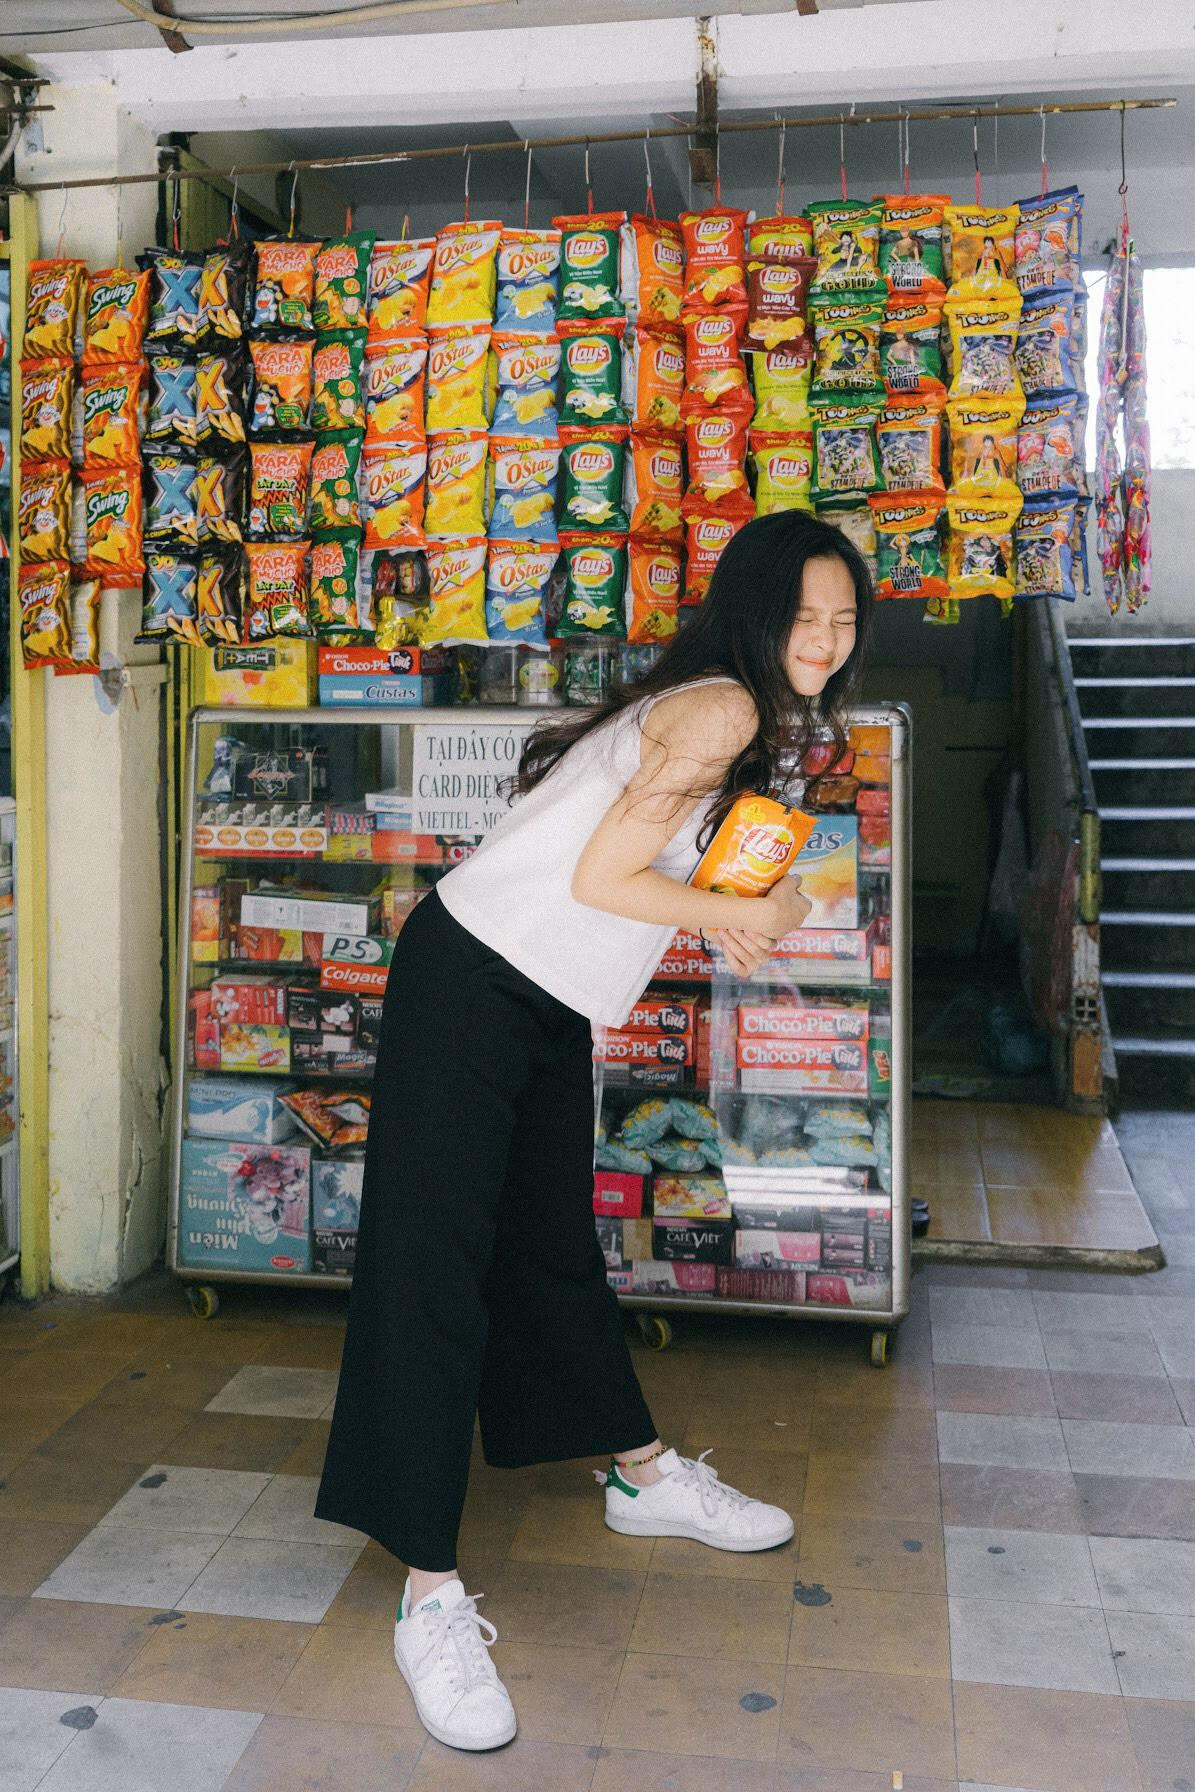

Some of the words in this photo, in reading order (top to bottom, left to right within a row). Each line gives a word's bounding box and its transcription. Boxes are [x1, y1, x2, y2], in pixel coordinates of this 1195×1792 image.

[697, 243, 729, 256] wavy
[28, 277, 67, 308] Swing
[90, 282, 136, 315] Swing
[762, 293, 795, 306] wavy
[698, 344, 730, 358] wavy
[22, 378, 58, 409] Swing
[85, 388, 126, 422] Swing
[698, 448, 730, 460] wavy
[19, 485, 54, 516] Swing
[88, 492, 128, 522] Swing
[697, 552, 721, 562] wav
[890, 566, 920, 579] STRONG
[892, 577, 922, 590] WORLD
[21, 580, 57, 609] Swing
[427, 736, 452, 767] TẠI
[457, 729, 490, 760] ĐÂY
[493, 729, 515, 760] CÓ
[419, 774, 461, 798] CARD
[418, 811, 472, 830] VIETTEL
[323, 966, 387, 985] Colgate
[666, 1231, 691, 1240] CAFÉ
